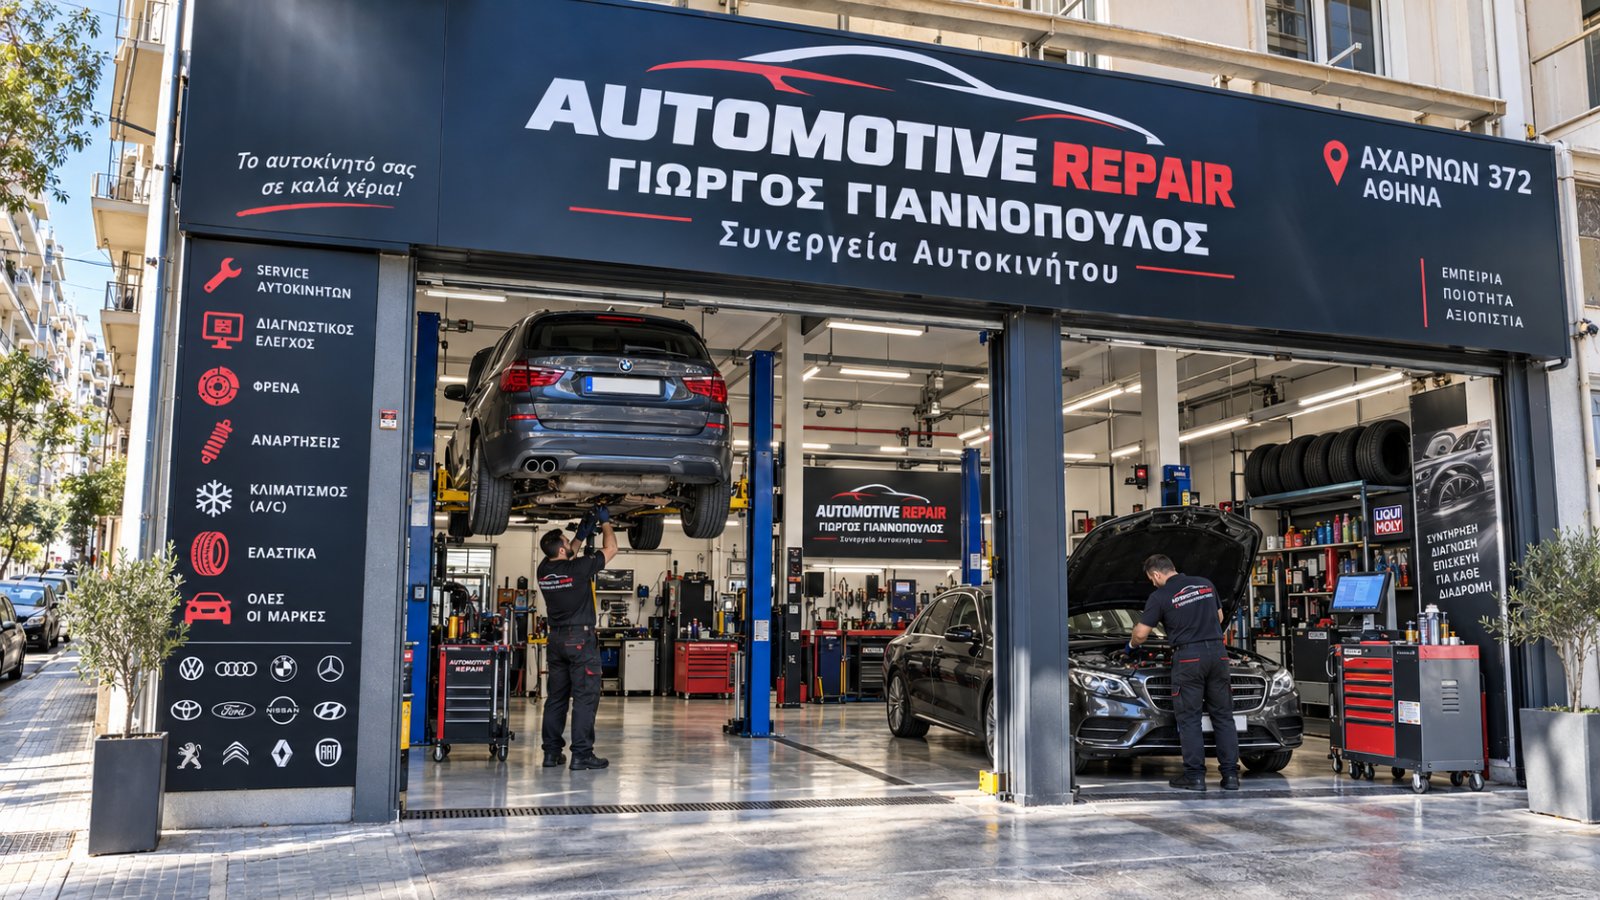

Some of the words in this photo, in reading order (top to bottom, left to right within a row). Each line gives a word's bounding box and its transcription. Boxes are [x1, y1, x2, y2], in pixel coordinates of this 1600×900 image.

[524, 77, 1038, 184] AUTOMOTIVE
[1052, 141, 1236, 209] REPAIR
[237, 152, 259, 170] Το
[265, 152, 376, 175] αυτοκίνητό
[382, 161, 417, 180] σας
[1360, 145, 1479, 187] ΑΧΑΡΝΩΝ
[1488, 164, 1532, 195] 372
[261, 180, 285, 196] σε
[290, 175, 340, 194] καλά
[343, 177, 403, 199] χέρια!
[1363, 177, 1442, 209] ΑΘΗΝΑ
[607, 157, 825, 211] ΓΙΩΡΓΟΣ
[847, 181, 1210, 256] ΓΙΑΝΝΟΠΟΥΛΟΣ
[718, 219, 897, 264] Συνεργεία
[912, 239, 1119, 285] Αυτοκινήτου
[257, 264, 309, 280] SERVICE
[1441, 266, 1503, 286] ΕΜΠΕΙΡΙΑ
[257, 281, 352, 300] ΑΥΤΟΚΙΝΗΤΩΝ
[1443, 287, 1514, 308] ΠΟΙΟΤΗΤΑ
[255, 317, 355, 336] ΔΙΑΓΝΩΣΤΙΚΟΣ
[1446, 308, 1524, 329] ΑΞΙΟΠΙΣΤΙΑ
[255, 335, 316, 350] ΕΛΕΓΧΟΣ
[252, 380, 301, 394] ΦΡΕΝΑ
[251, 434, 341, 449] ΑΝΑΡΤΗΣΕΙΣ
[249, 483, 349, 498] ΚΛΙΜΑΤΙΣΜΟΣ
[249, 500, 288, 514] (A/C)
[815, 504, 900, 519] AUTOMOTIVE
[902, 505, 947, 520] REPAIR
[1375, 508, 1401, 521] LIQUI
[819, 521, 861, 533] ΓΙΩΡΓΟΣ
[863, 522, 945, 534] ΓΙΑΝΝΟΠΟΥΛΟΣ
[1376, 519, 1401, 533] MOLY
[247, 546, 317, 560] ΕΛΑΣΤΙΚΑ
[1431, 537, 1479, 558] ΔΙΑΓΝΩΣΗ
[1433, 552, 1480, 571] ΕΠΙΣΚΕΥΗ
[1436, 574, 1451, 585] ΓΙΑ
[1453, 567, 1480, 582] ΚΑΘΕ
[247, 592, 285, 606] ΟΛΕΣ
[1439, 580, 1493, 600] ΔΙΑΔΡΟΜΗ
[246, 610, 262, 623] ΟΙ
[267, 610, 327, 624] ΜΑΡΚΕΣ
[220, 705, 246, 716] Ford
